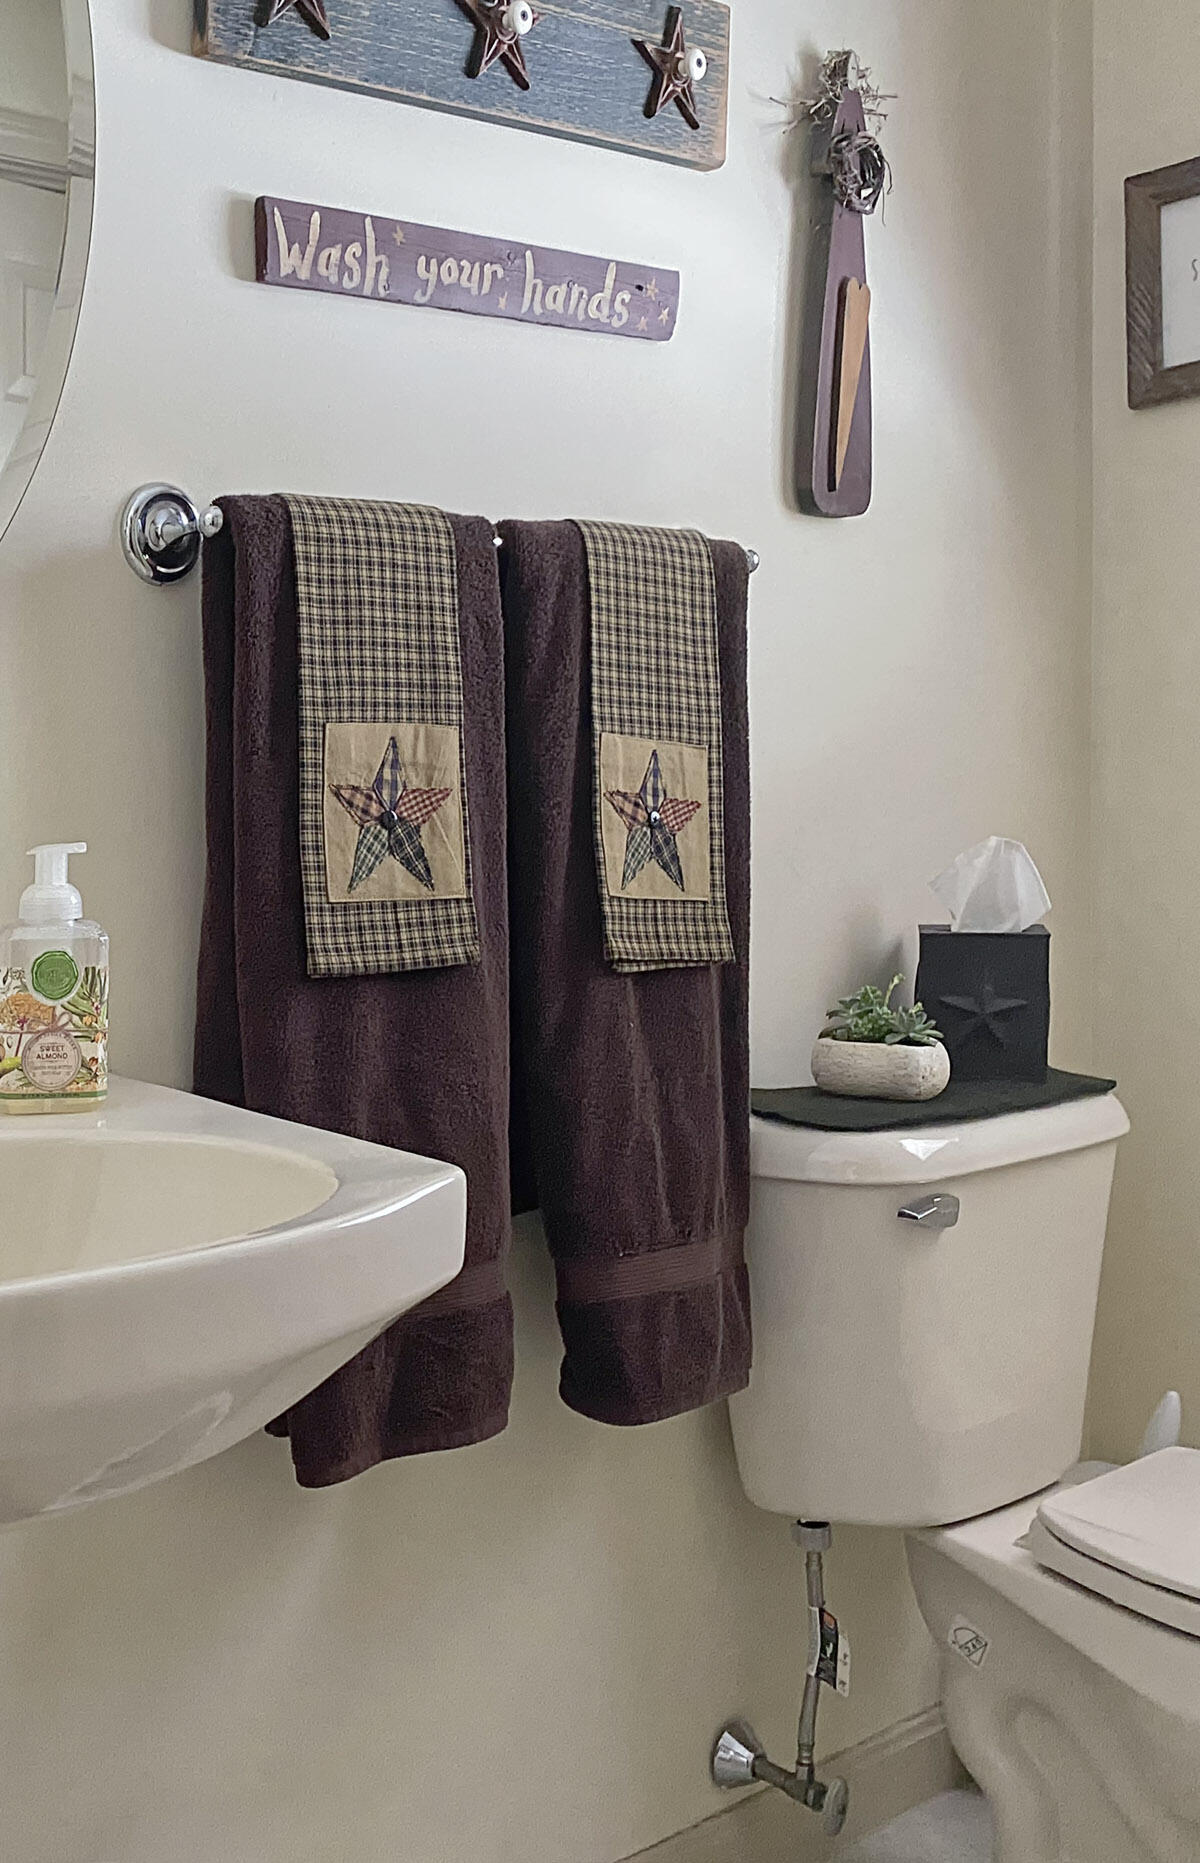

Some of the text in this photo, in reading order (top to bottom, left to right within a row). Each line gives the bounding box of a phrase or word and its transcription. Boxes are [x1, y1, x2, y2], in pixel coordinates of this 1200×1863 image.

[274, 206, 631, 328] Wash your hands
[36, 1052, 68, 1060] ALMOND
